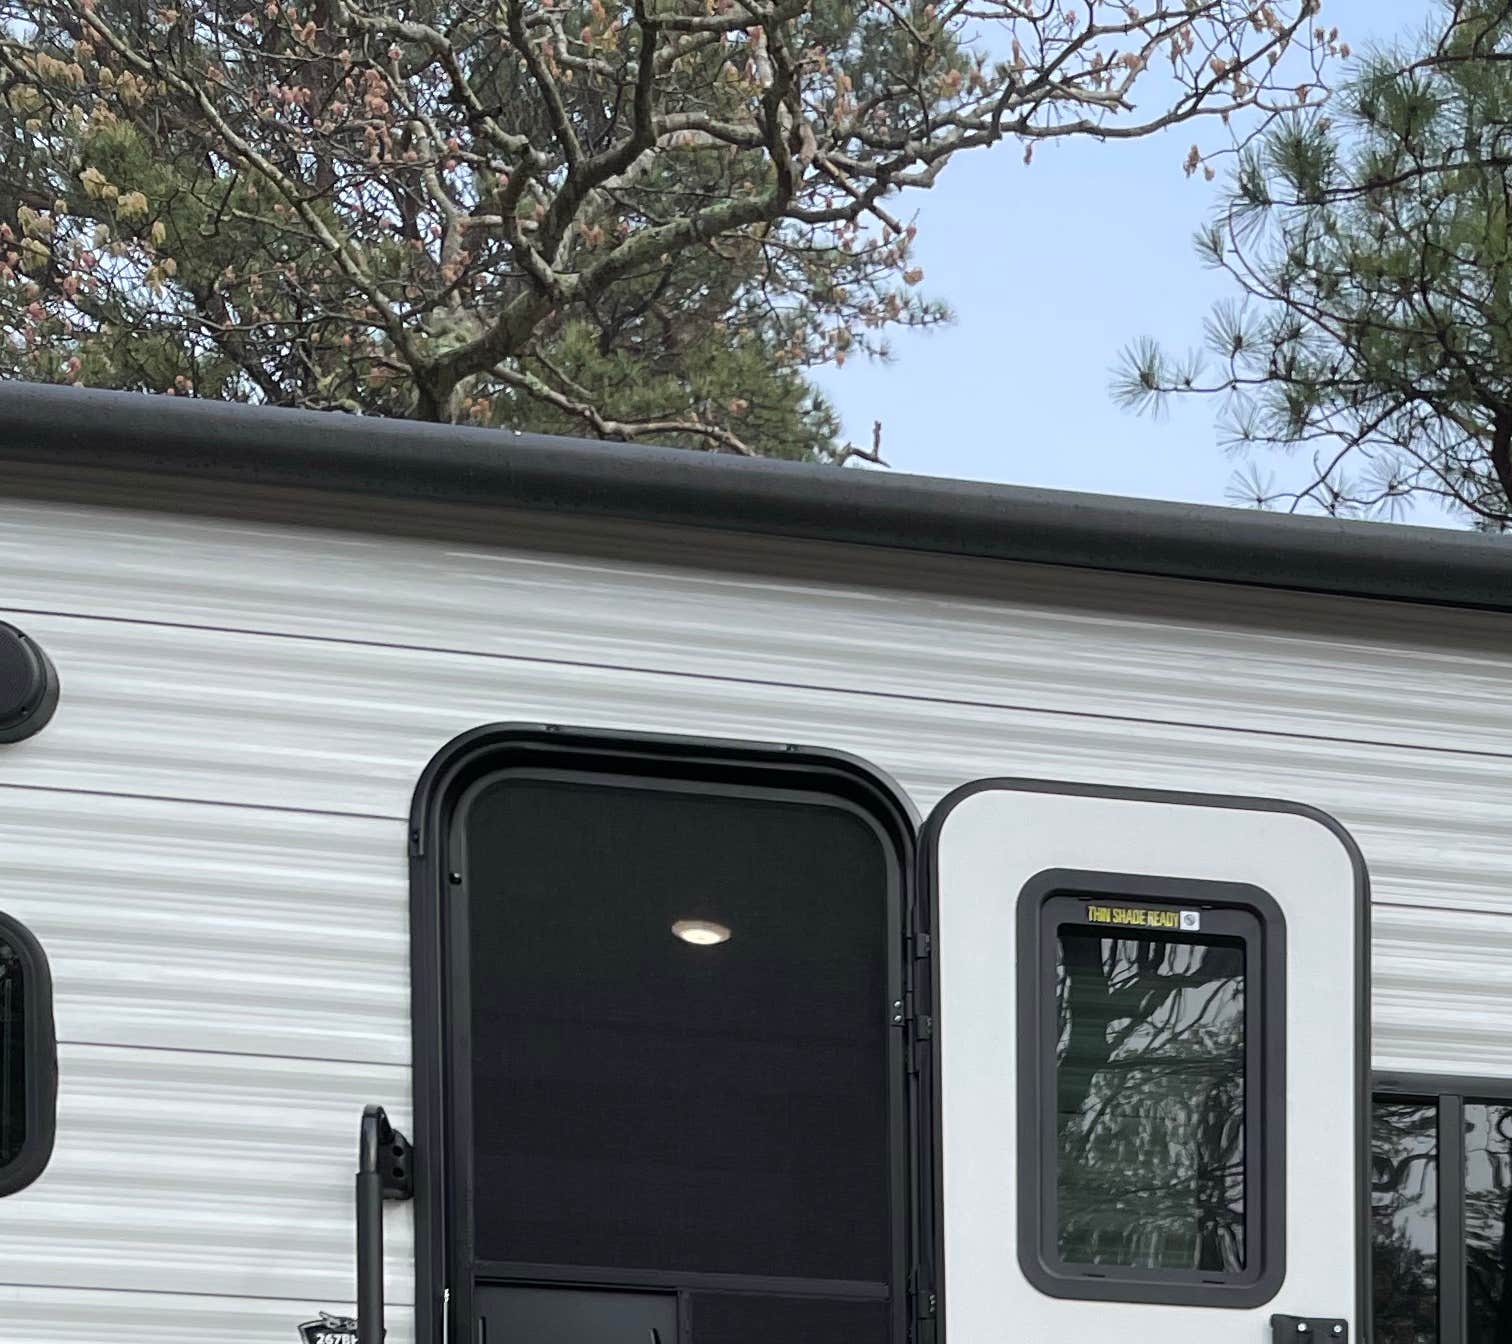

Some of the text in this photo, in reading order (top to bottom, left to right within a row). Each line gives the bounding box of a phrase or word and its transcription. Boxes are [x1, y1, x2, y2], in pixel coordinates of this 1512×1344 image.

[1088, 906, 1179, 928] THIN SHADE READY
